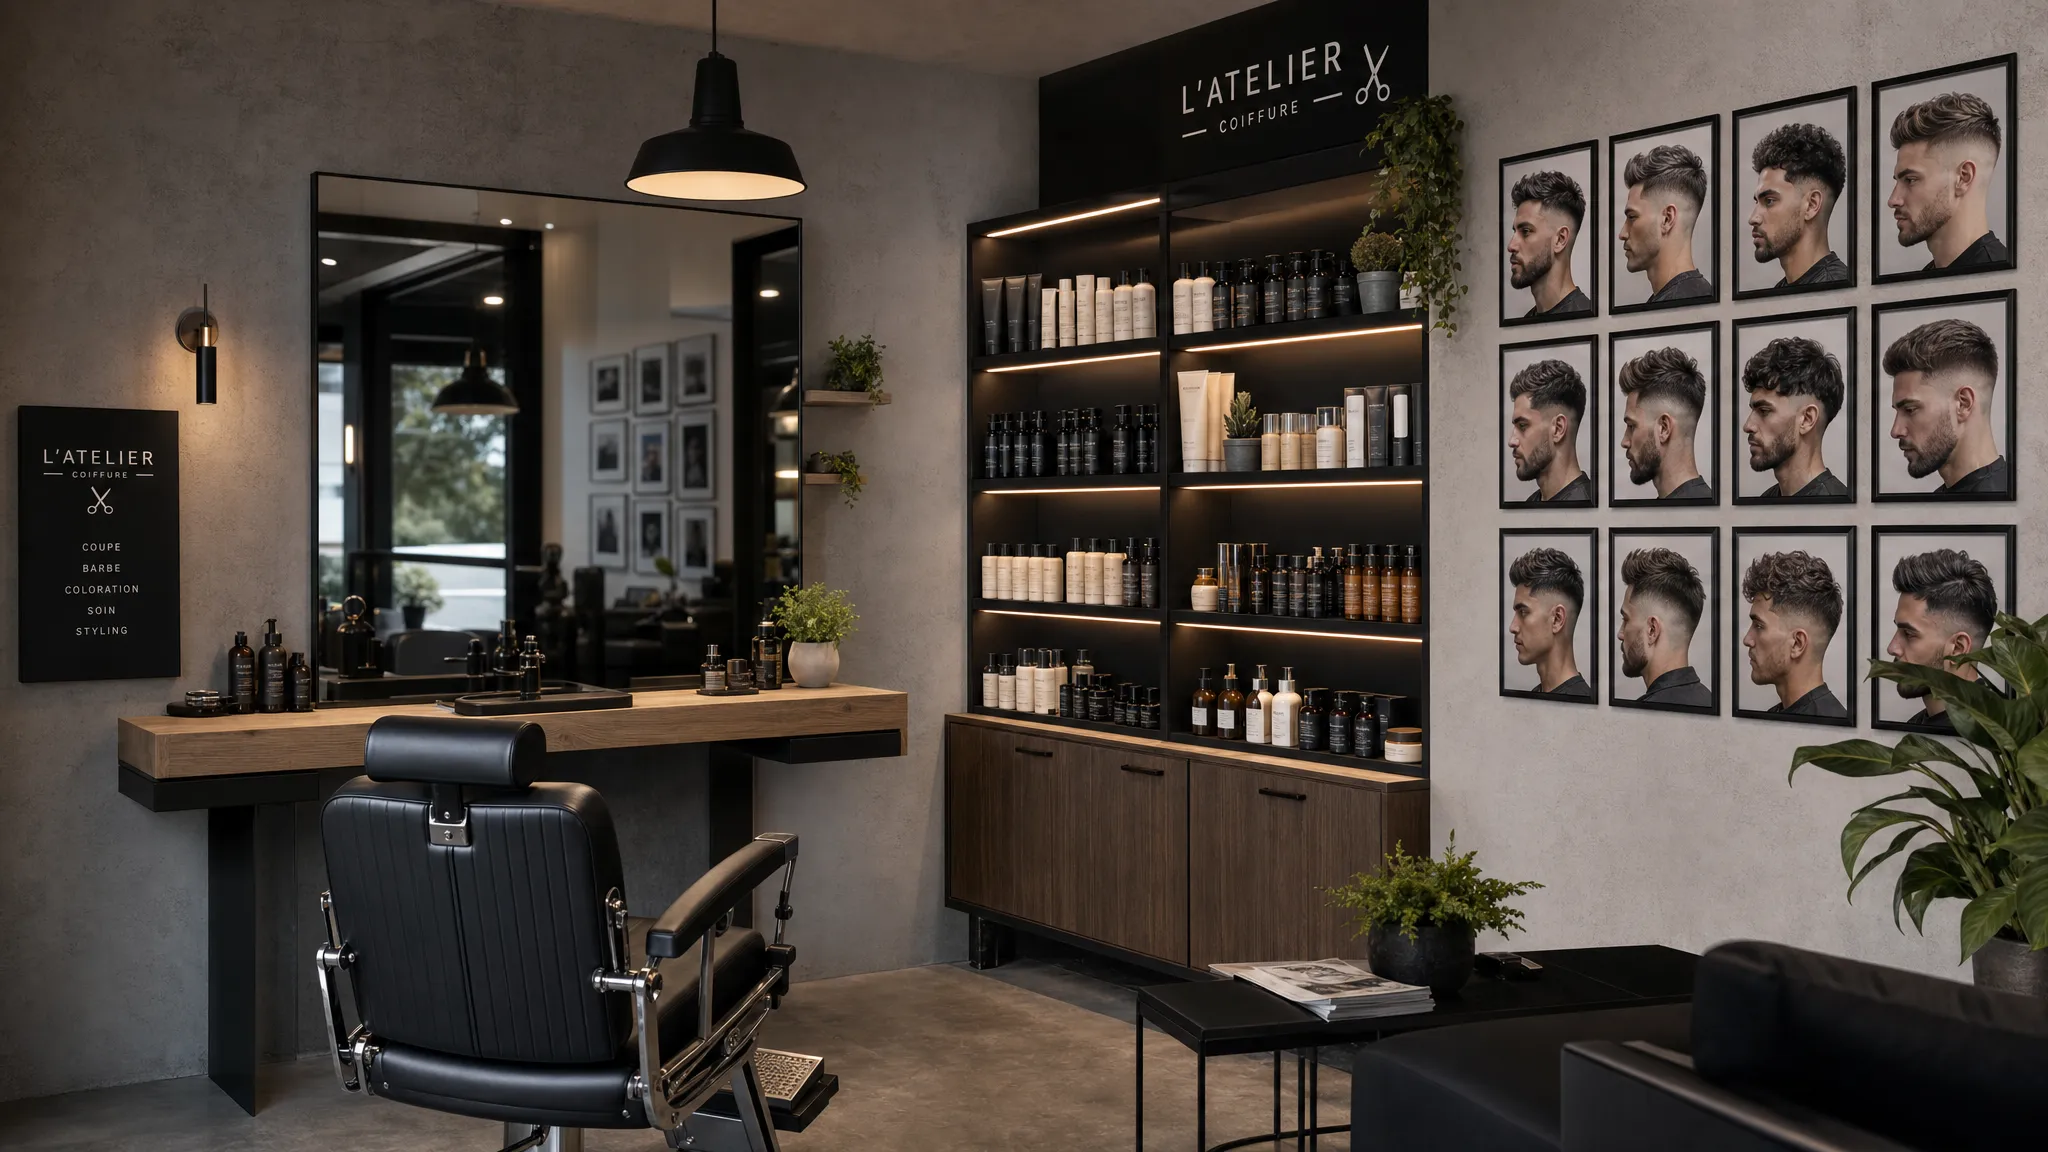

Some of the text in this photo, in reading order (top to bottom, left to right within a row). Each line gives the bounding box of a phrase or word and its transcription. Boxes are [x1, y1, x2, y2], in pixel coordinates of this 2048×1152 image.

[1182, 41, 1342, 115] L'ATELIER
[1219, 100, 1299, 133] COIFFURE
[43, 449, 154, 466] L'ATELIER
[72, 471, 128, 479] COIFFURE
[82, 543, 121, 552] COUPE
[82, 564, 121, 573] BARBE
[64, 585, 139, 595] COLORATION
[87, 606, 116, 615] SOIN
[76, 626, 128, 636] STYLING
